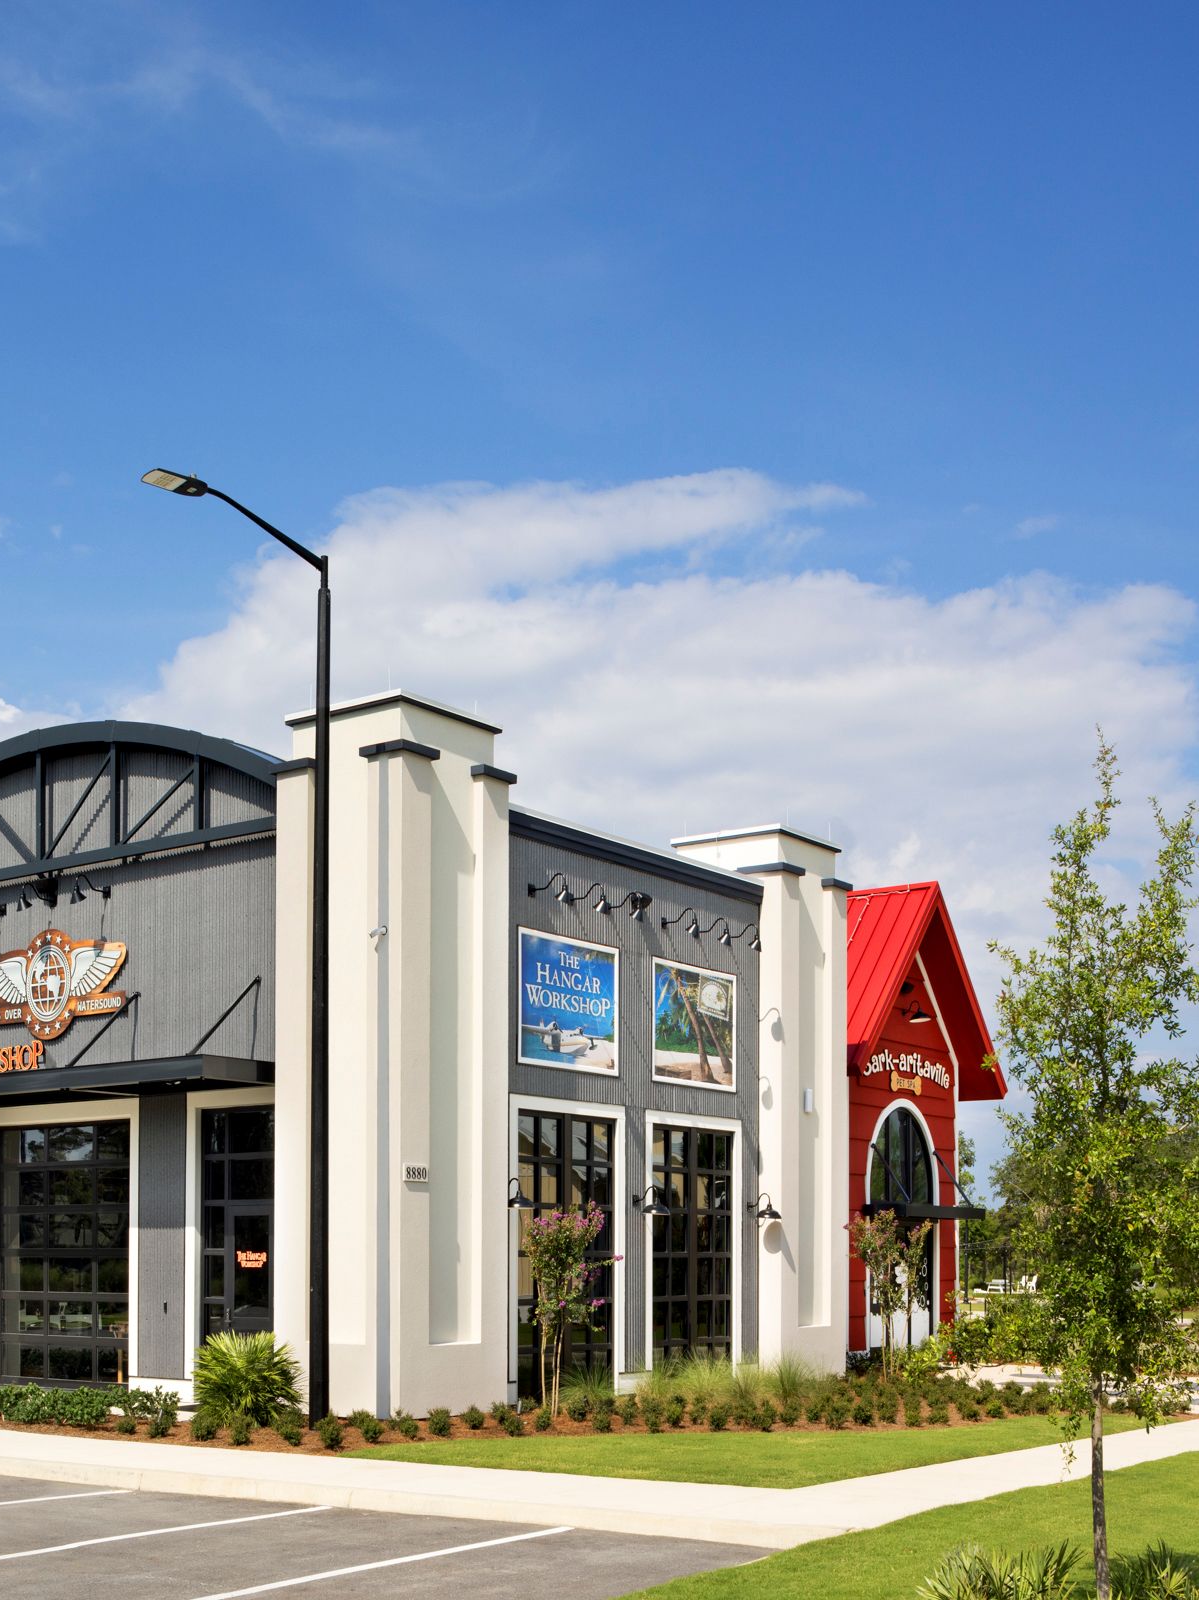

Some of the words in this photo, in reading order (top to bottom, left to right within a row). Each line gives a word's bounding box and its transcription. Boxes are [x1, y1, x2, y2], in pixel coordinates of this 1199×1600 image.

[558, 950, 580, 970] THE
[536, 962, 601, 995] HANGAR
[4, 1008, 22, 1020] OVER
[77, 996, 122, 1012] WATERSOUND
[525, 983, 611, 1018] WORKSHOP
[406, 1166, 427, 1180] 8880
